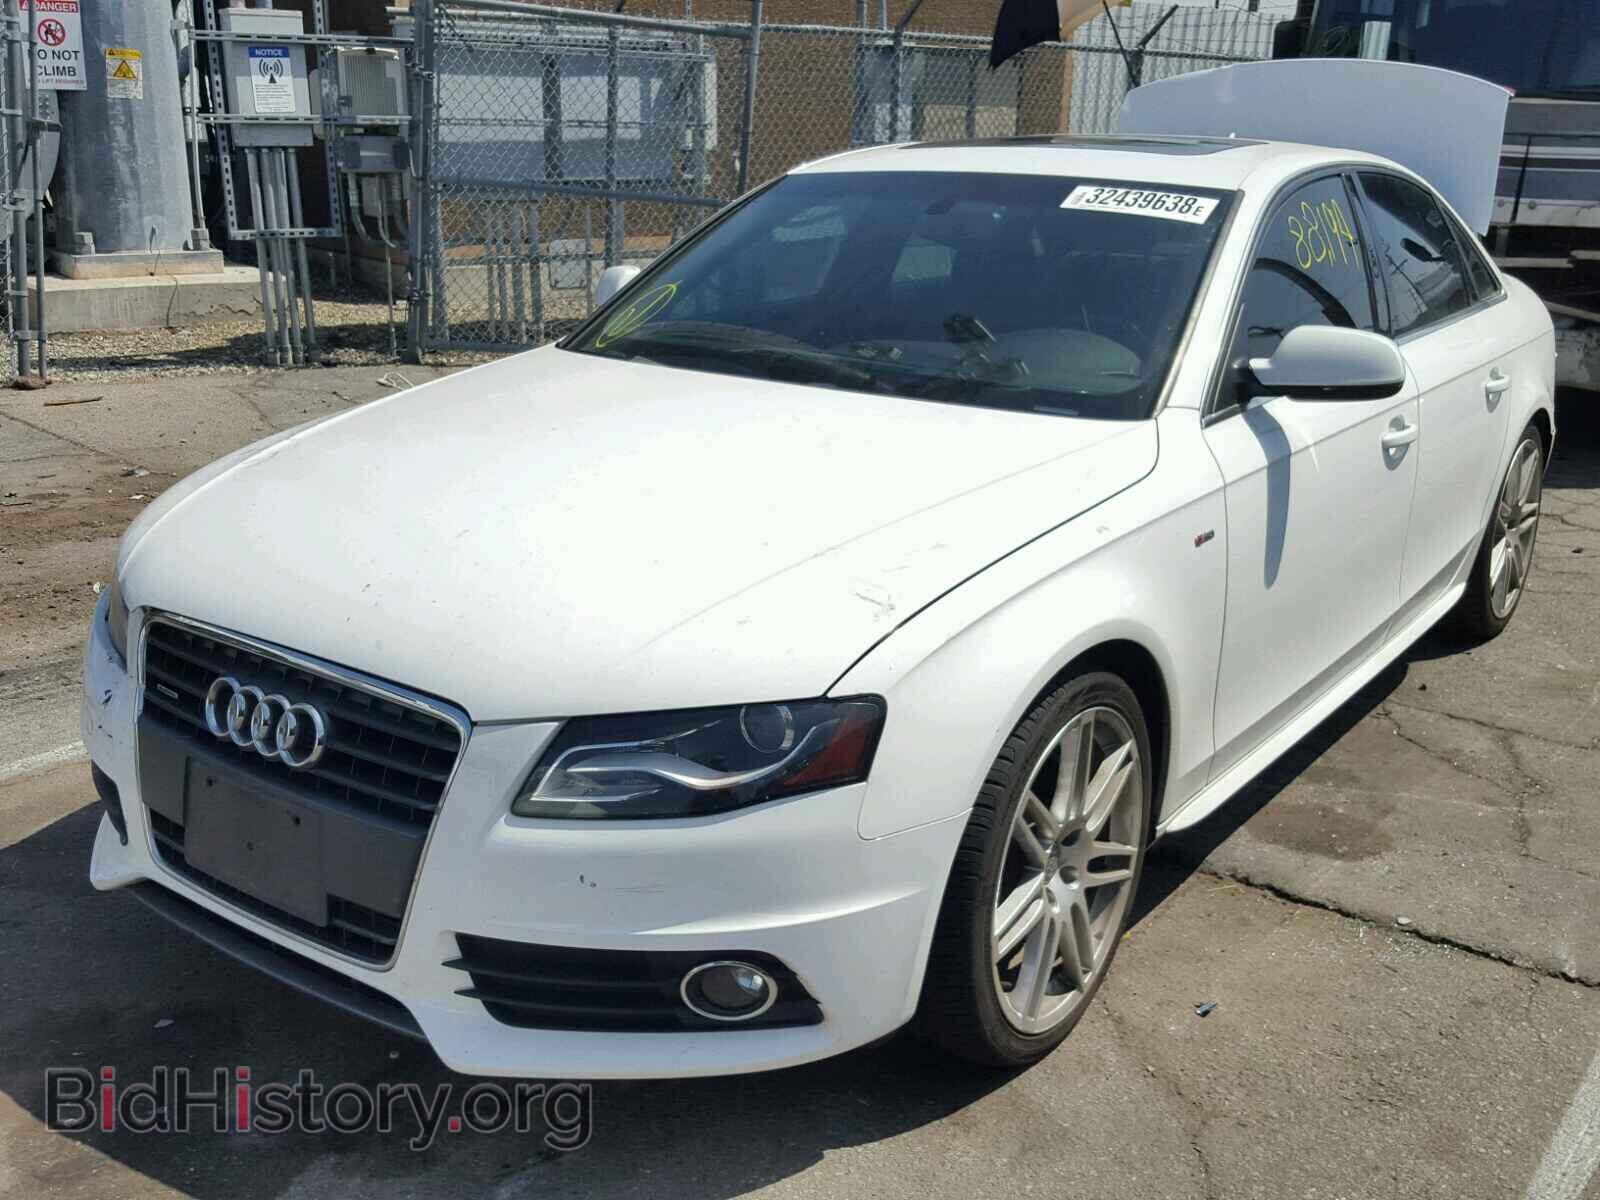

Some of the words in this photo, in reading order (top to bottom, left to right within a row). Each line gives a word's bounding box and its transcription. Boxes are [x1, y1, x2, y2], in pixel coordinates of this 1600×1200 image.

[51, 49, 80, 61] NOT
[255, 48, 282, 56] NOTICE
[1085, 187, 1199, 215] 32439638
[1193, 205, 1205, 217] E
